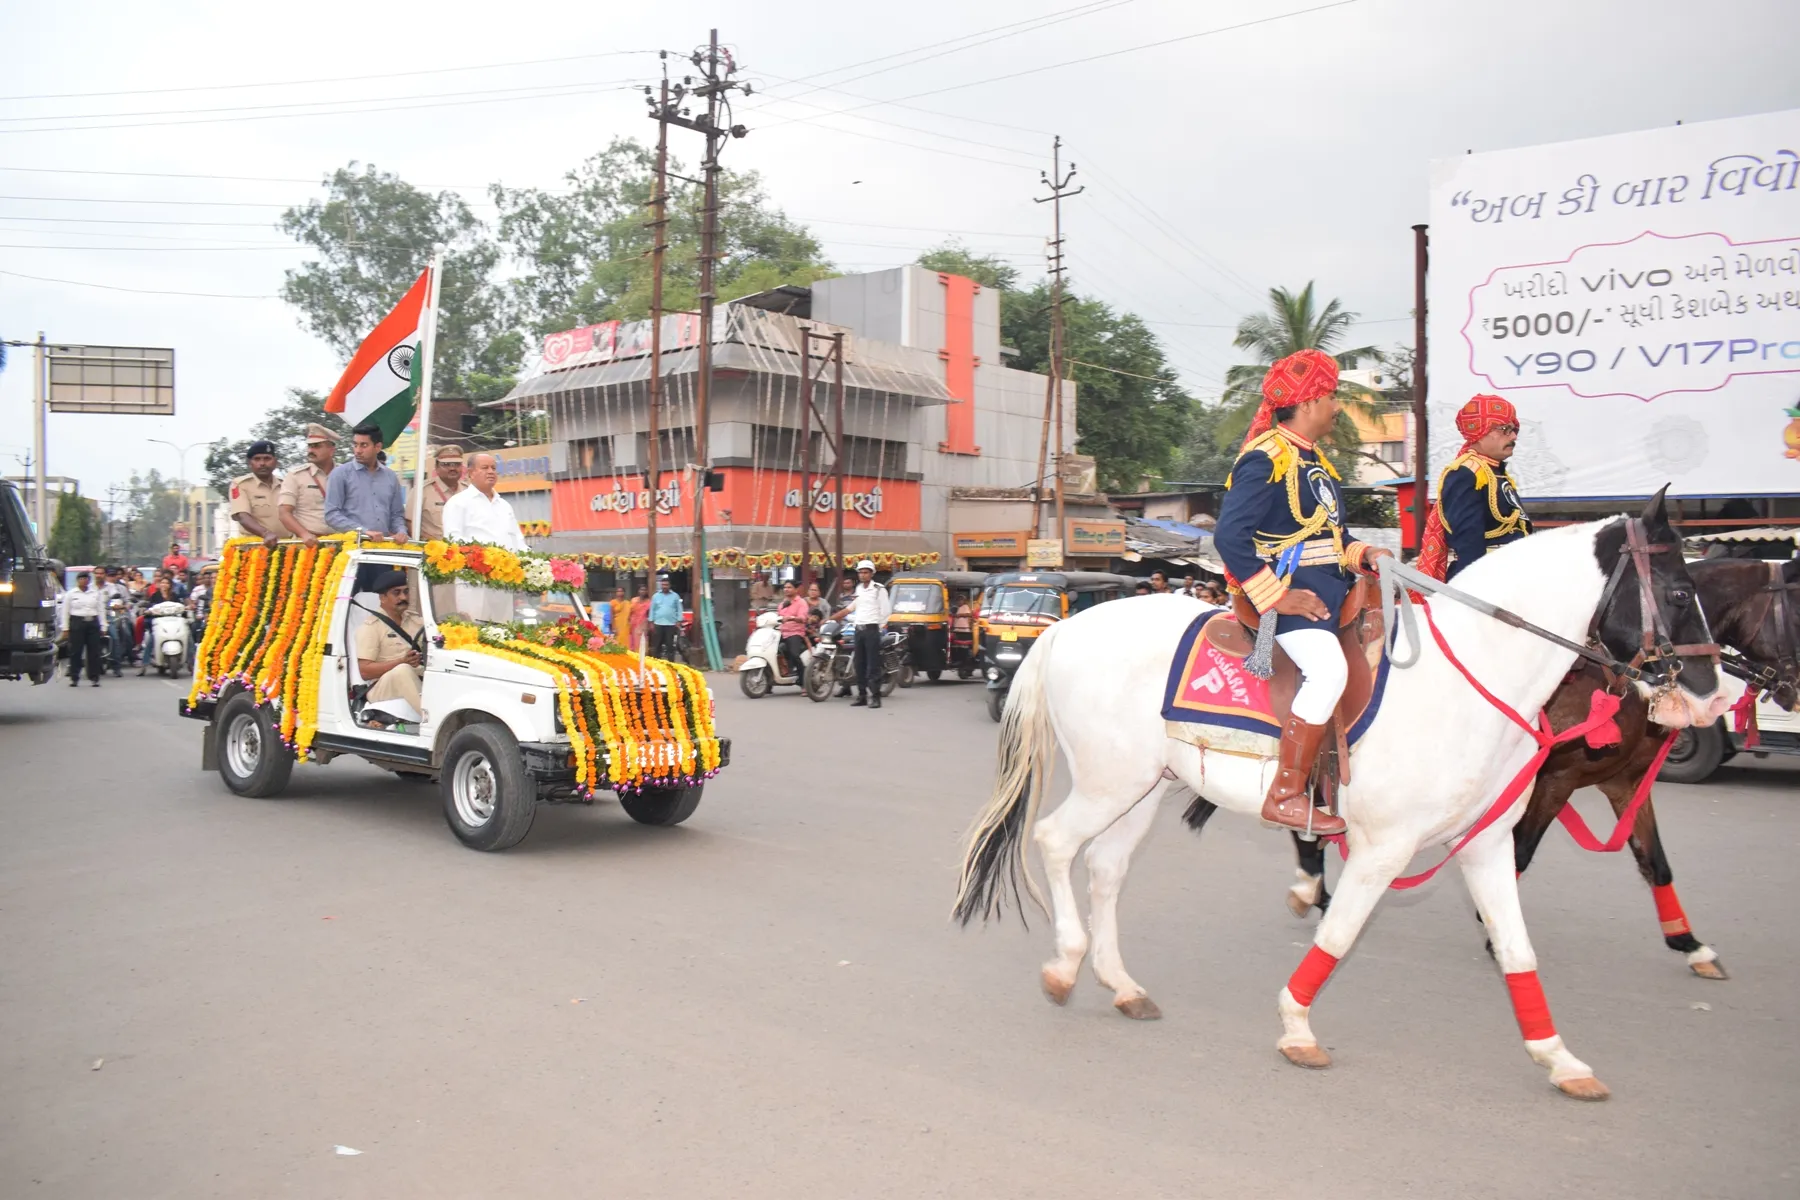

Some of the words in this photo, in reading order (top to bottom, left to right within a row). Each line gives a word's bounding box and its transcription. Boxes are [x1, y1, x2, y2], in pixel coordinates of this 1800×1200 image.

[1558, 174, 1600, 216] કી
[1612, 175, 1689, 207] બાર
[1503, 270, 1568, 299] ખરીદો
[1580, 268, 1673, 293] vivo
[1684, 255, 1728, 282] અને
[1670, 289, 1748, 320] કેશબેક
[1504, 349, 1596, 376] Y90
[1609, 346, 1625, 370] /
